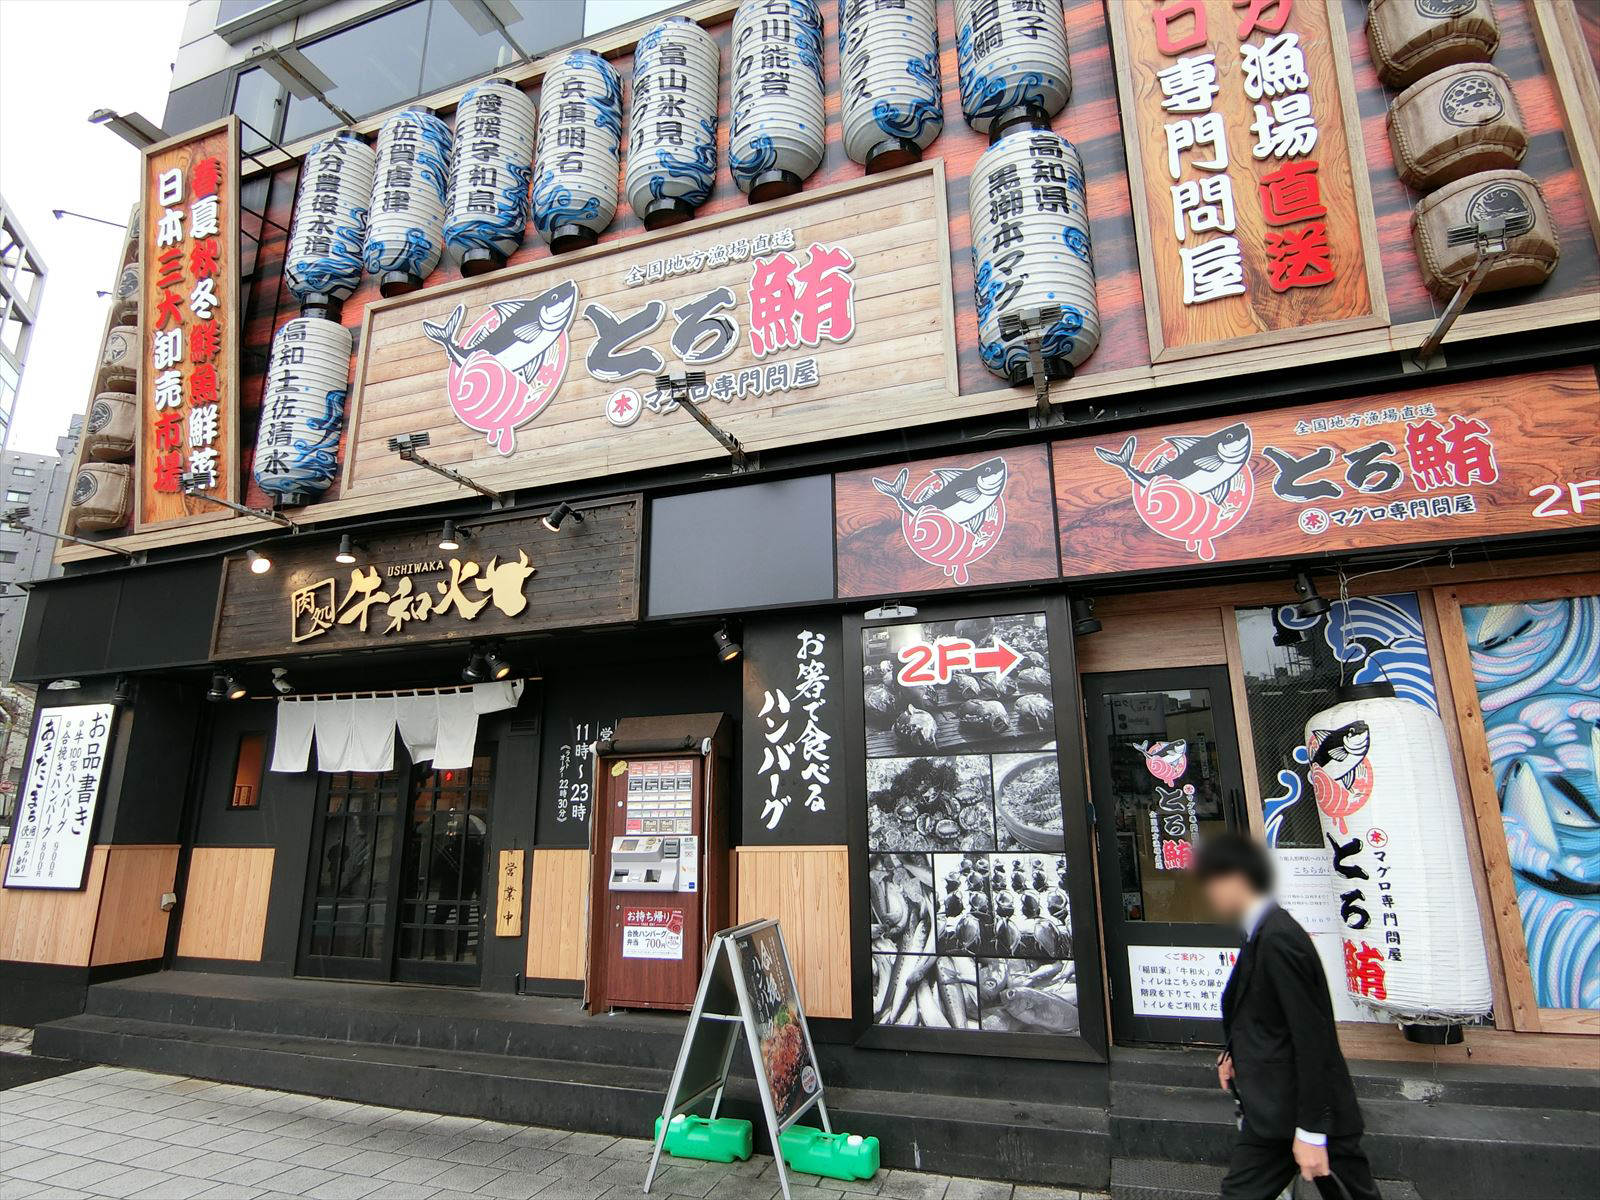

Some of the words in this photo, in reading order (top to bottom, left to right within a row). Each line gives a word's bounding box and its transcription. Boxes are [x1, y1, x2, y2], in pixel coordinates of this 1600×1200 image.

[556, 77, 587, 173] 兵庫明石
[654, 42, 687, 146] 富山氷見
[381, 120, 418, 213] 佐賀唐津
[466, 94, 503, 214] 愛媛宇和島
[1029, 134, 1070, 214] 高知県
[625, 229, 796, 286] 全国地方漁場直送
[583, 243, 856, 382] とろ鮪
[263, 321, 310, 475] 高知土佐清水
[611, 394, 633, 417] 本
[1295, 403, 1437, 436] 全国地方漁場直送
[1261, 415, 1500, 502] とろ鮪
[1529, 480, 1600, 518] 2F
[1330, 495, 1477, 528] マグロ専門問屋
[387, 560, 445, 578] USHIWAKA
[899, 639, 972, 685] 2F
[757, 688, 796, 830] ハンバーグ
[791, 629, 831, 812] お箸で食べる
[71, 711, 108, 835] お品書き
[1370, 832, 1386, 845] 本
[502, 862, 518, 926] 営業中
[626, 910, 671, 923] お持ち帰り
[1326, 831, 1387, 1001] とろ鮪
[1373, 850, 1402, 962] マグロ専門問屋
